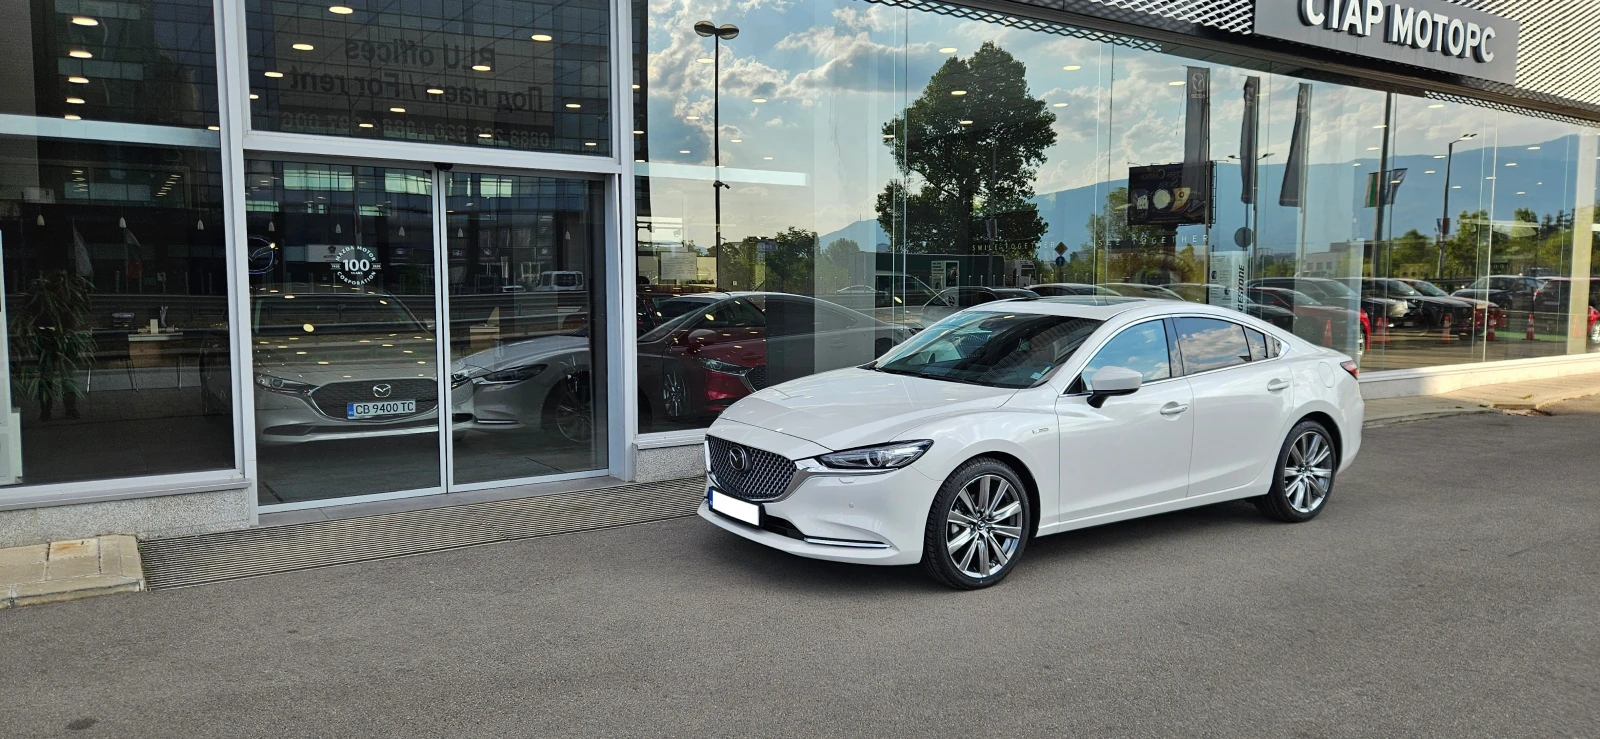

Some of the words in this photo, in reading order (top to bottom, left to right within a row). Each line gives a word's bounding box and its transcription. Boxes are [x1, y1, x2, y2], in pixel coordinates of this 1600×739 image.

[1301, 0, 1384, 37] СТАР
[1388, 4, 1497, 63] МОТОРС
[335, 245, 355, 262] MAZDA
[356, 245, 376, 262] MOTOR
[343, 259, 371, 272] 100
[336, 271, 377, 286] CORPORATION
[356, 404, 370, 415] CB
[372, 402, 399, 414] 9400
[401, 401, 414, 412] TC
